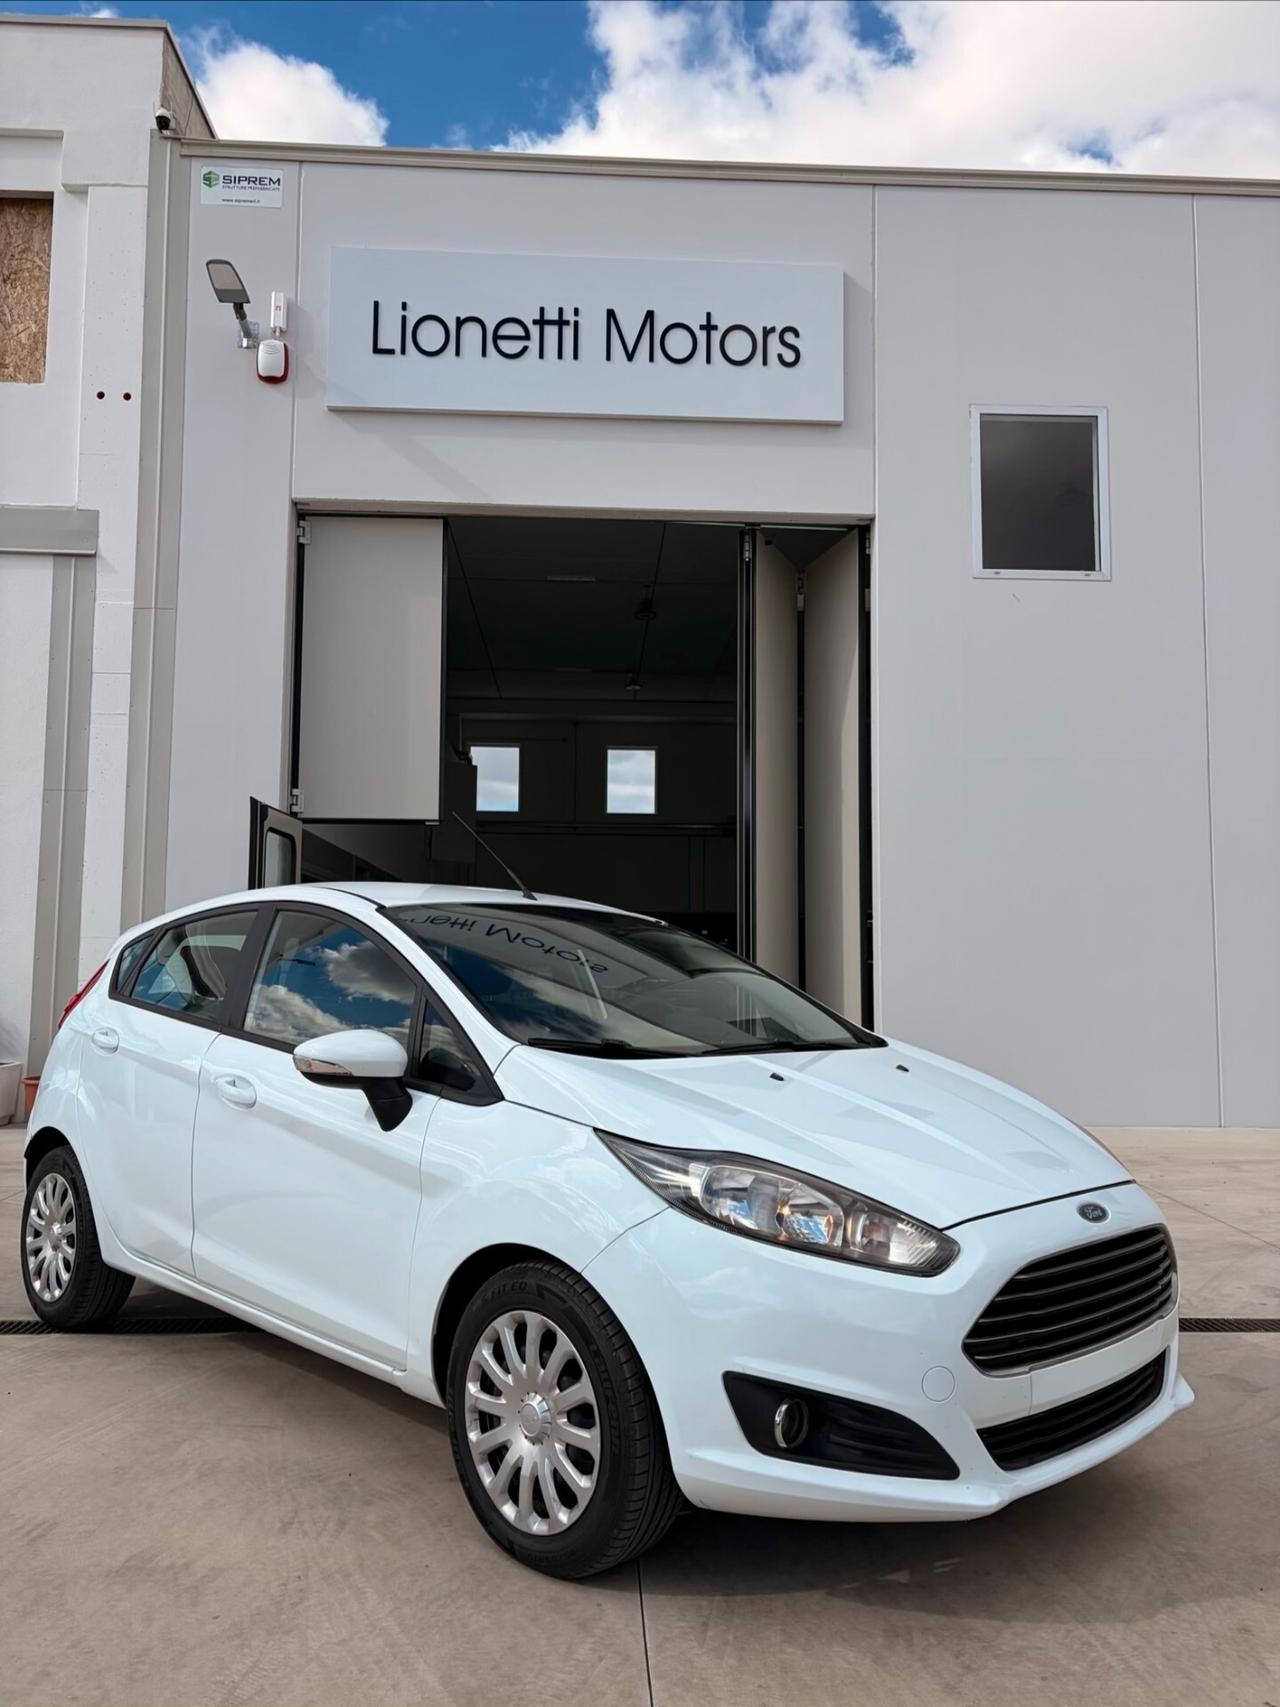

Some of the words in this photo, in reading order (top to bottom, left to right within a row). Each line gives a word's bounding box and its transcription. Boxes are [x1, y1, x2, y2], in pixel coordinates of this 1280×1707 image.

[222, 175, 281, 187] SIPREM
[372, 300, 580, 361] Lionetti
[605, 308, 801, 369] Motors
